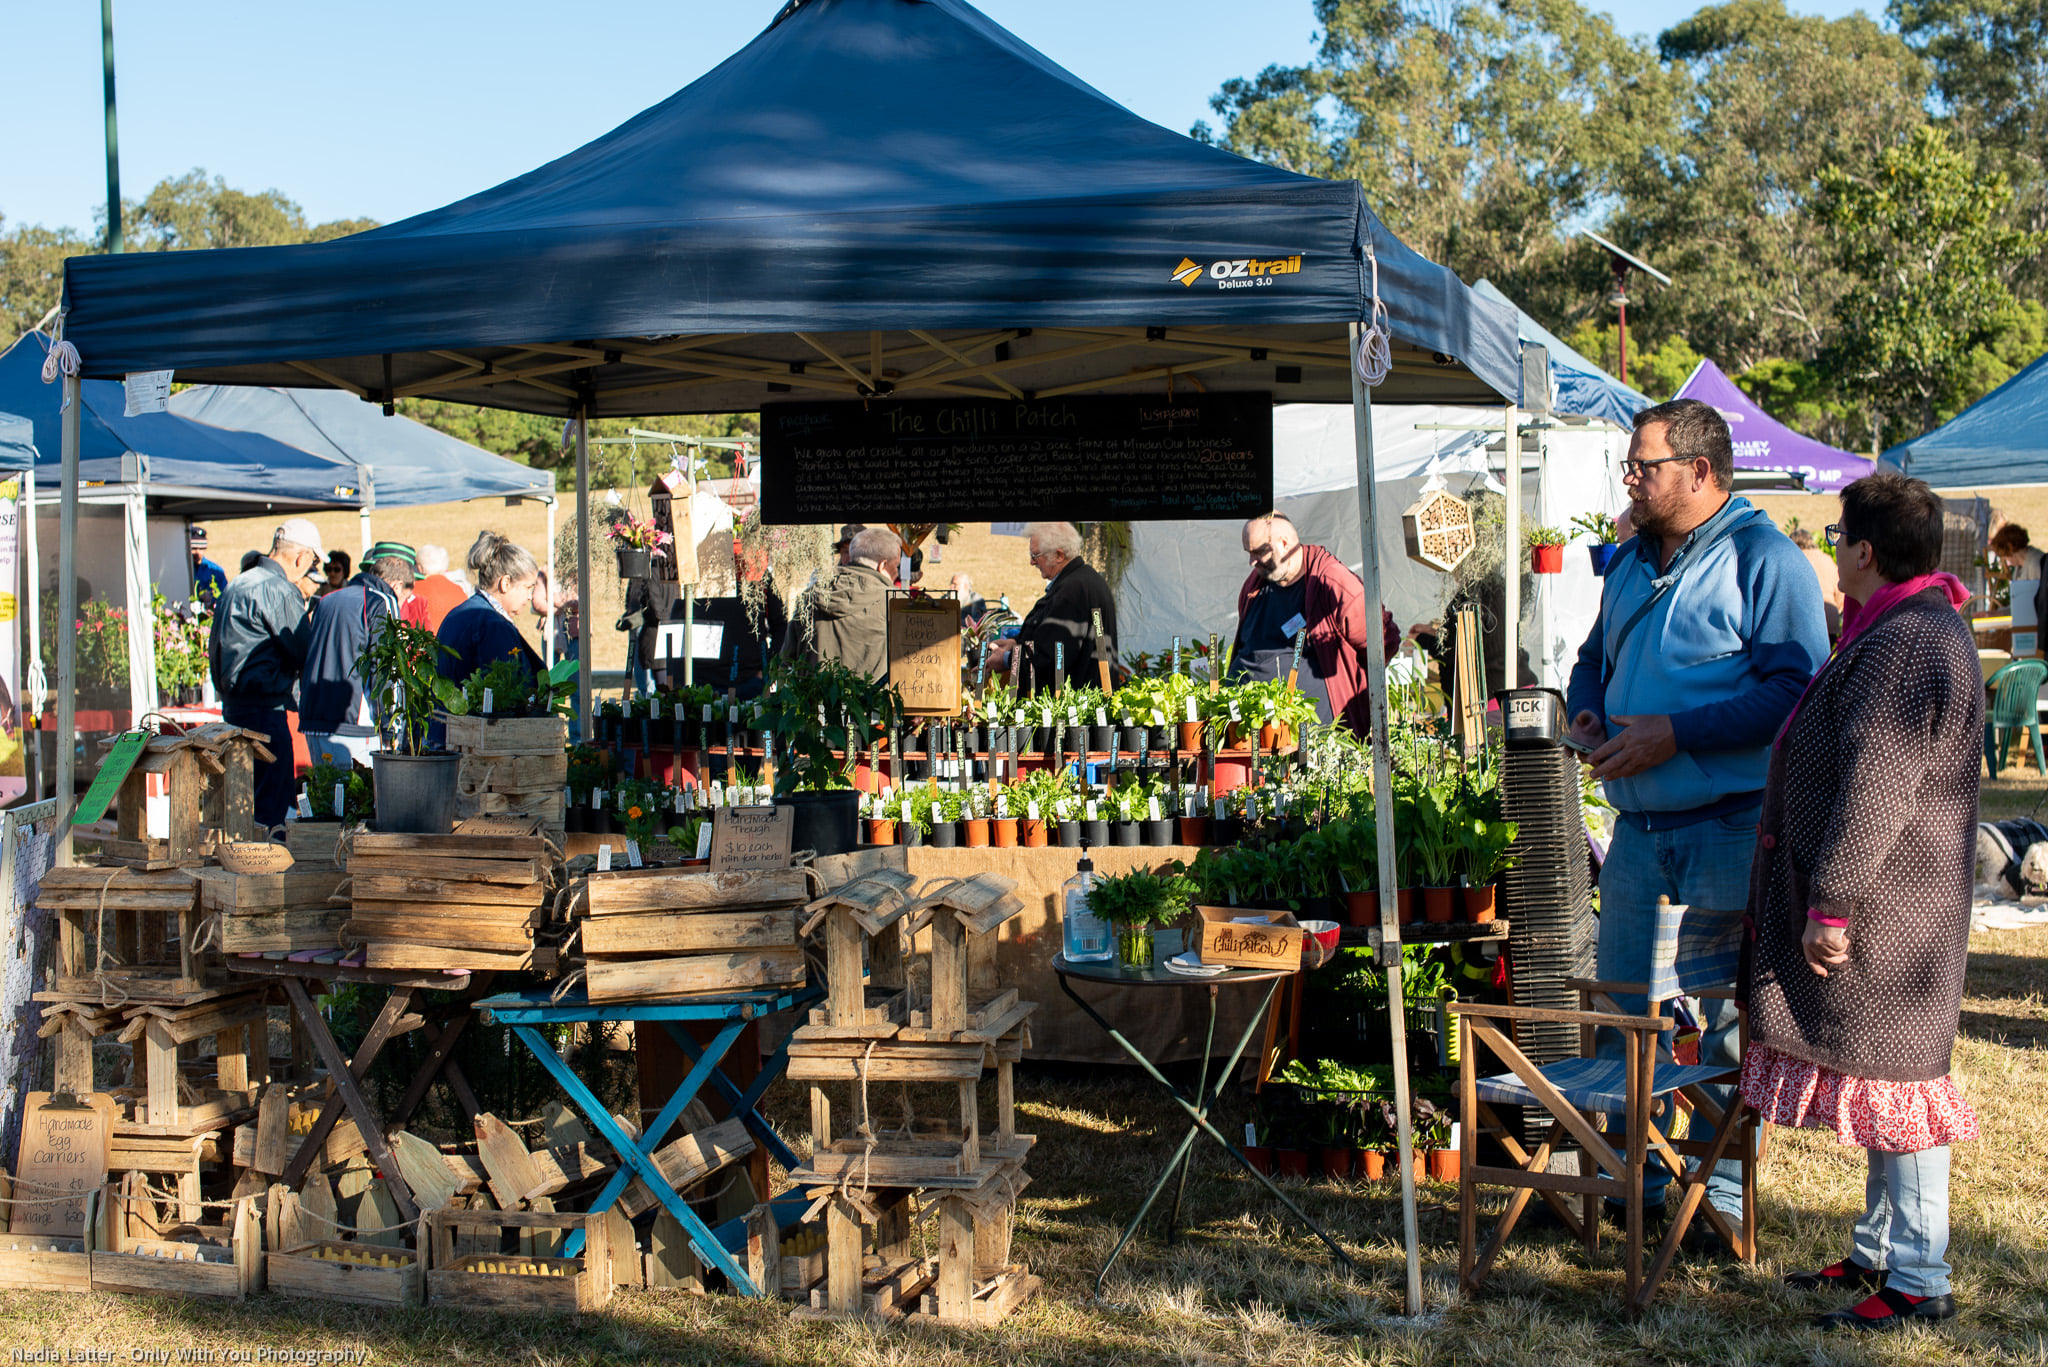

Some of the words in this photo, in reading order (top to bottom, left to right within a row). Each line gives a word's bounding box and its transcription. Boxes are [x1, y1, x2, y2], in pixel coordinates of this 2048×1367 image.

[1210, 255, 1301, 279] OZtrail
[1218, 279, 1254, 290] Deluxe
[1256, 277, 1273, 287] 3.0
[880, 406, 926, 433] The
[936, 407, 997, 434] Chilli
[1015, 403, 1077, 430] Patch
[846, 446, 866, 458] and
[870, 445, 906, 457] create
[911, 447, 924, 457] all
[929, 447, 946, 457] our
[1001, 443, 1015, 453] on
[1046, 442, 1072, 451] acre
[1075, 437, 1103, 451] farm
[1106, 439, 1119, 449] at
[1162, 438, 1183, 450] Our
[1187, 437, 1232, 448] business
[1731, 440, 1769, 449] ALLEY
[965, 456, 989, 465] sons
[1027, 452, 1048, 462] and
[1200, 448, 1222, 463] 20
[1224, 450, 1254, 464] years
[1732, 448, 1771, 457] CIETY
[1819, 469, 1842, 482] MP
[0, 514, 17, 526] SE
[904, 628, 937, 641] Herbs
[903, 650, 920, 665] $3
[921, 653, 942, 665] each
[915, 669, 927, 679] or
[911, 680, 924, 697] for
[927, 680, 943, 695] $10
[730, 824, 770, 836] Trough
[725, 842, 746, 854] $10
[748, 842, 774, 853] each
[760, 853, 782, 861] herbs
[39, 1115, 94, 1132] Handmade
[48, 1135, 71, 1150] Egg
[33, 1150, 86, 1164] Carriers
[64, 1210, 84, 1225] $20
